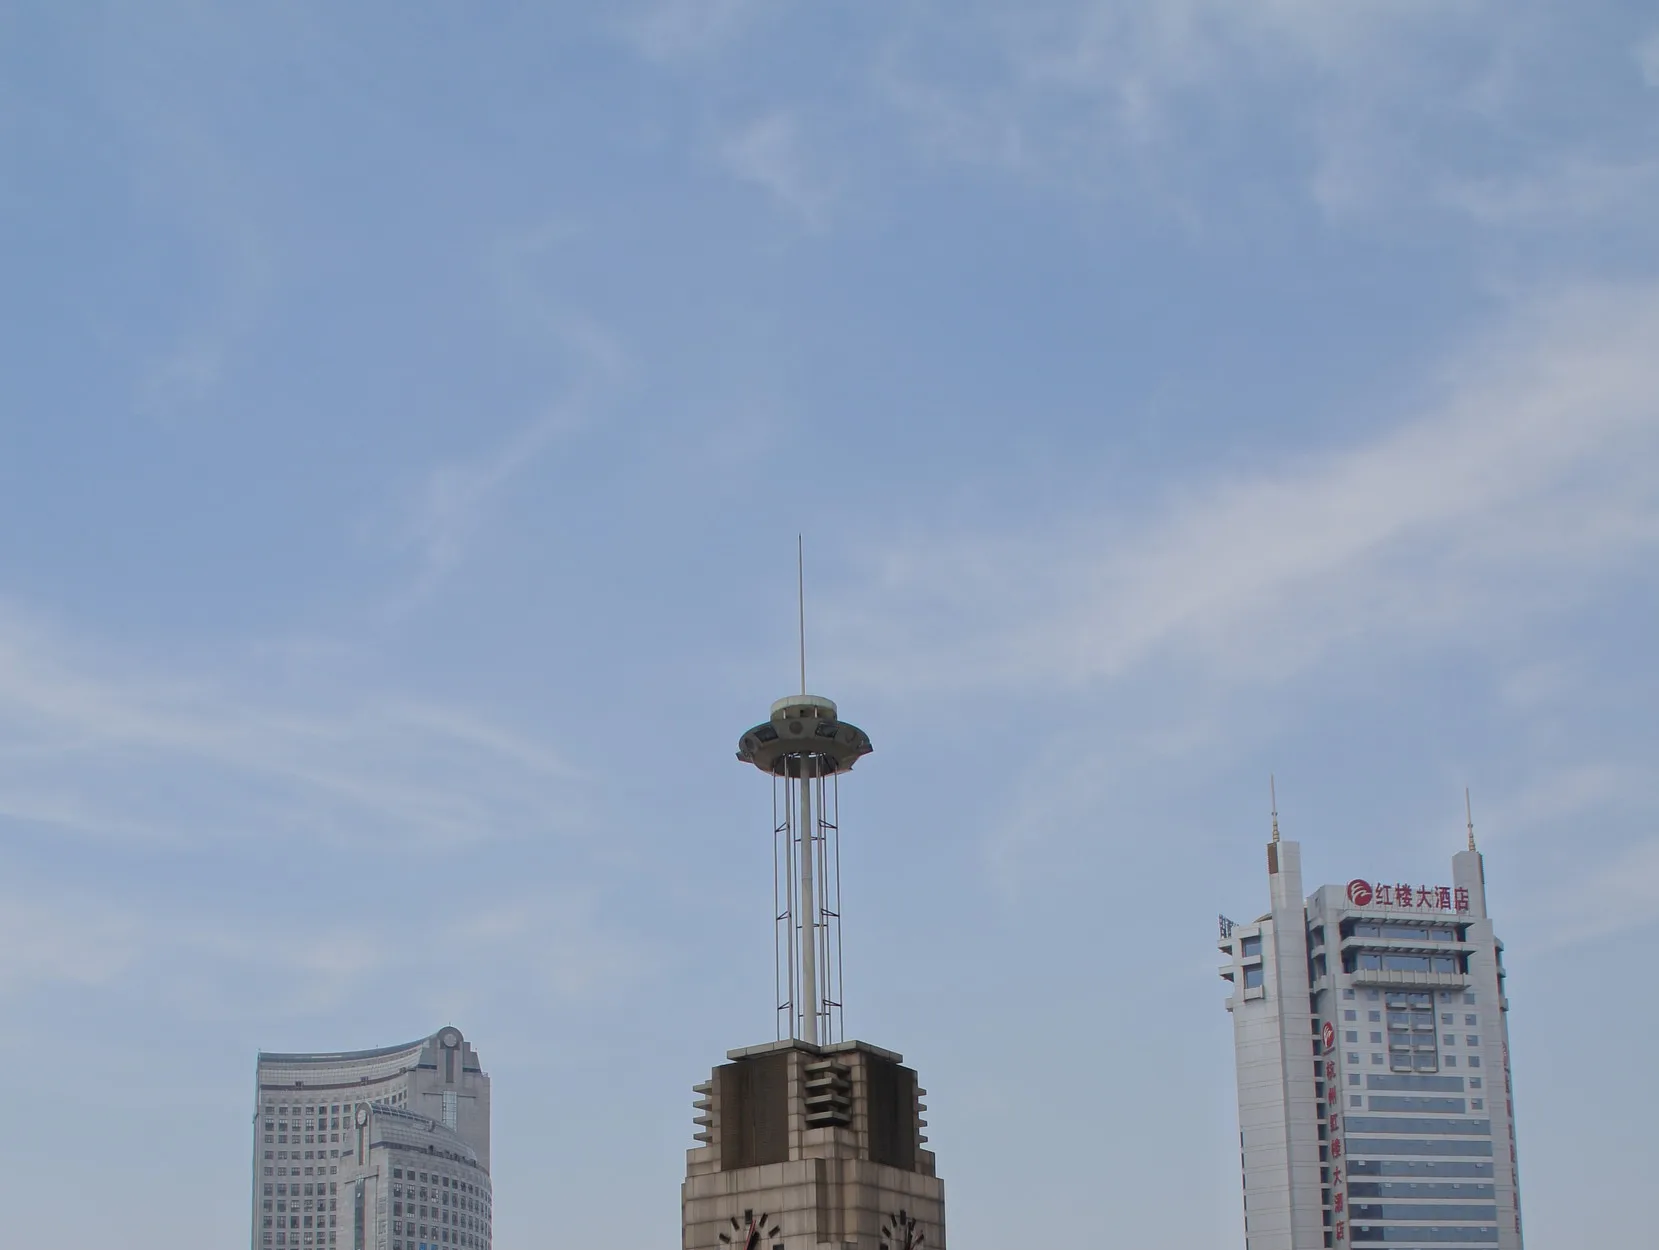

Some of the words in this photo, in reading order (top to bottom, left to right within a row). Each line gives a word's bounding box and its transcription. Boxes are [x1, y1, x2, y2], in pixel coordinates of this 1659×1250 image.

[1375, 882, 1469, 911] 红楼大酒店
[1325, 1060, 1345, 1242] 杭州红楼大酒店
